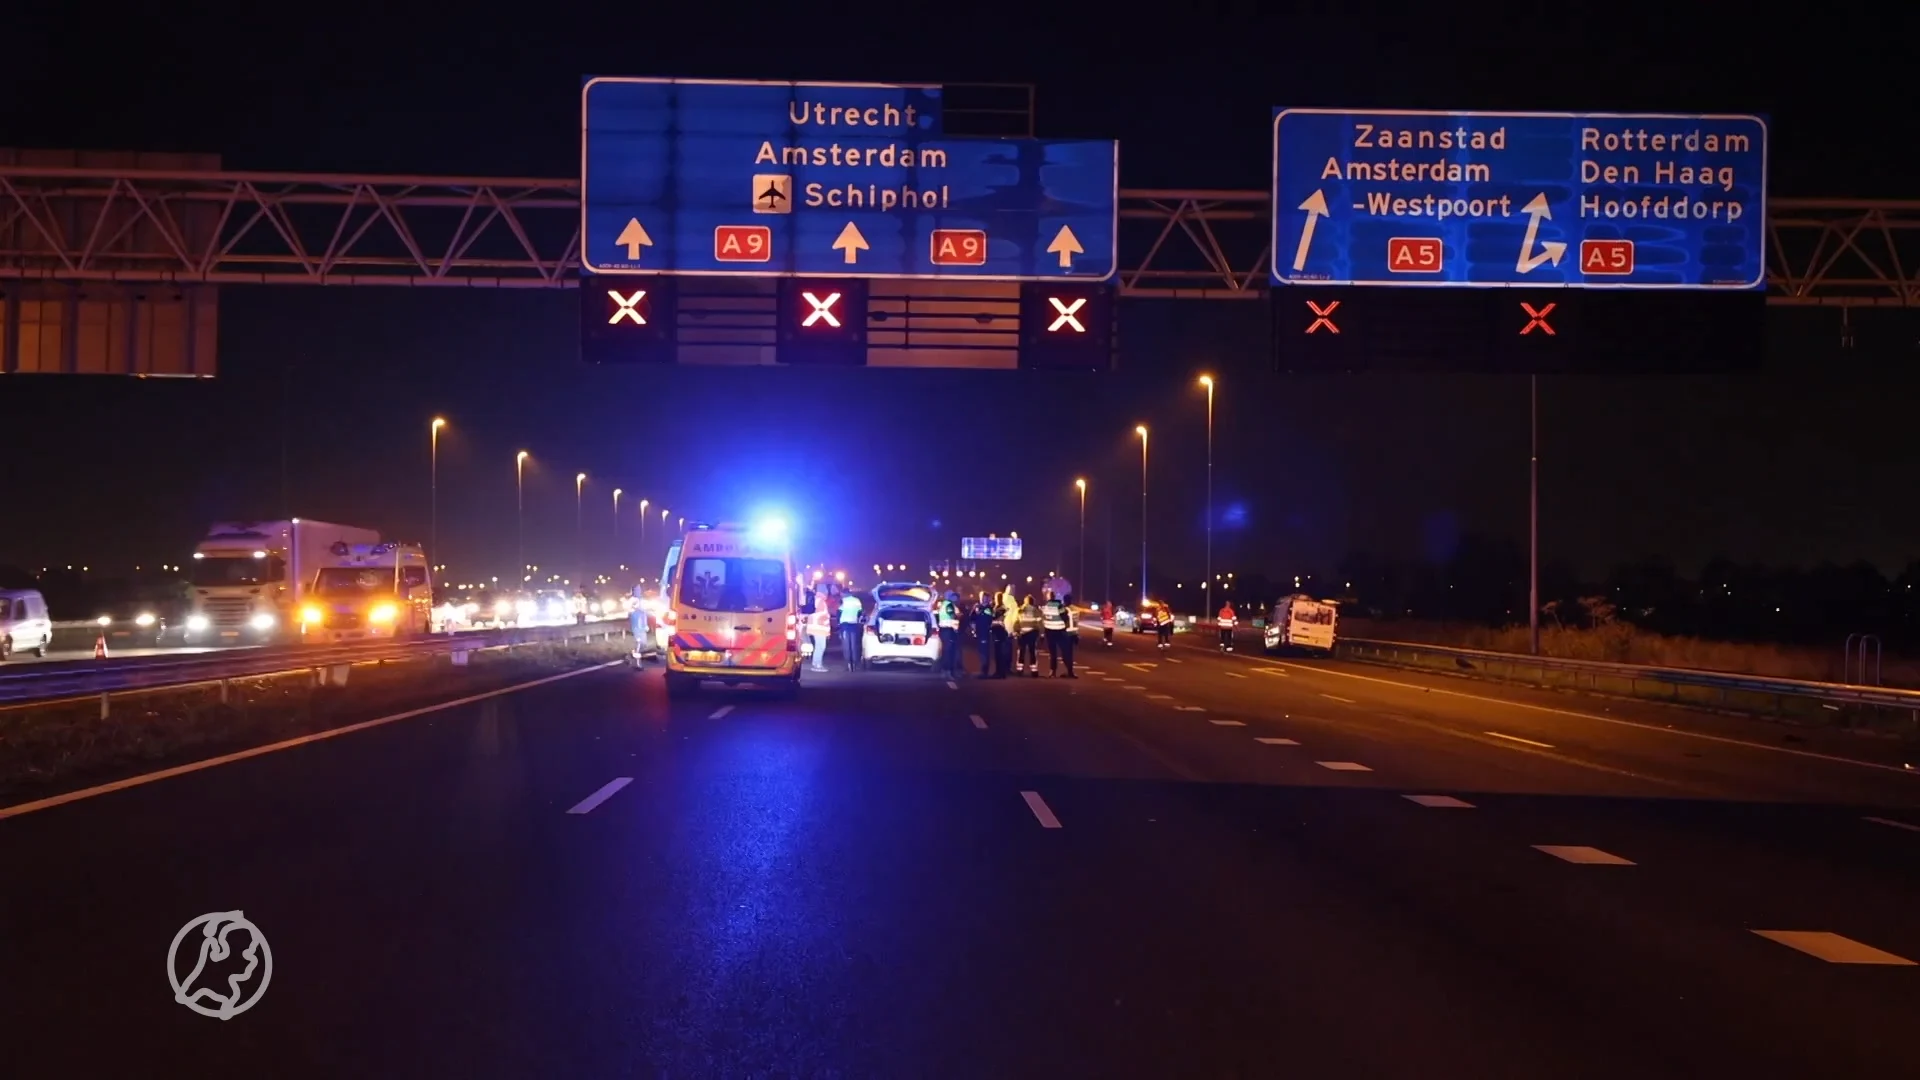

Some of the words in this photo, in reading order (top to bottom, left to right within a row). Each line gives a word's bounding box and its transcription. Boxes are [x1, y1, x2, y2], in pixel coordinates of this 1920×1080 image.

[788, 101, 918, 127] Utrecht
[1354, 124, 1507, 150] Zaanstad
[1581, 127, 1750, 152] Rotterdam
[754, 140, 947, 168] Amsterdam
[1321, 156, 1490, 182] Amsterdam
[1581, 160, 1640, 184] Den
[1655, 161, 1735, 192] Haag
[805, 182, 950, 211] Schiphol
[1352, 192, 1511, 221] -Westpoort
[1580, 195, 1743, 224] Hoofddorp
[722, 233, 763, 254] A9
[939, 237, 978, 257] A9
[1394, 245, 1435, 265] A5
[1587, 247, 1626, 268] A5
